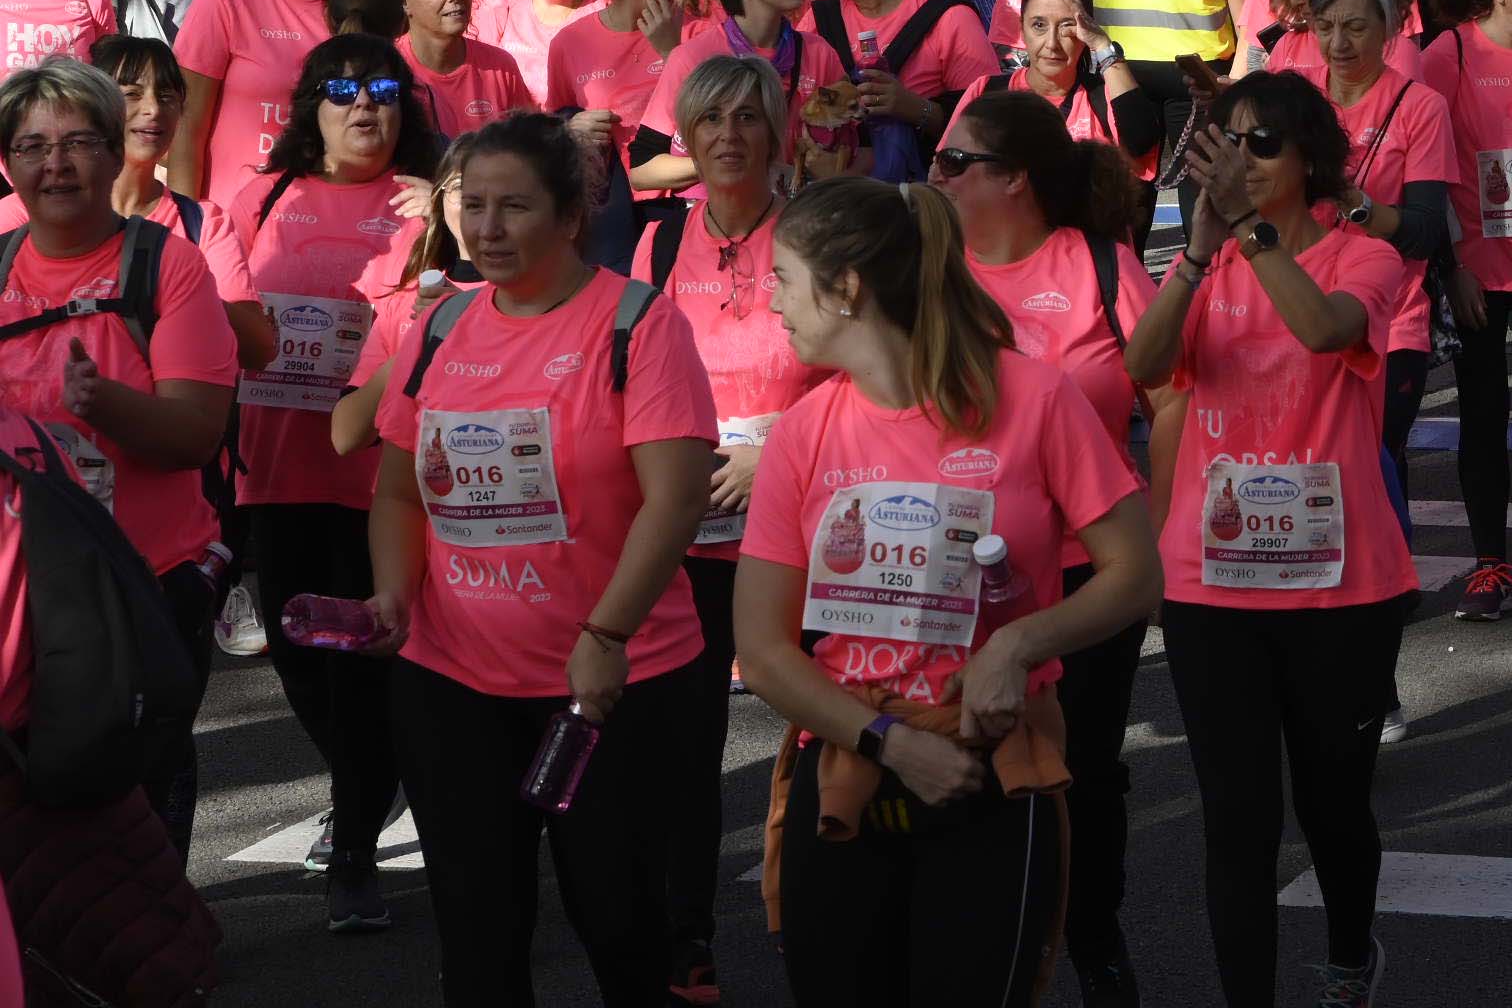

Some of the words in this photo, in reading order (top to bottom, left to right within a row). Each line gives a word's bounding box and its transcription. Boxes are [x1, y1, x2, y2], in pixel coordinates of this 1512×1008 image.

[7, 23, 80, 54] HOY
[260, 28, 302, 41] OYSHO
[576, 68, 616, 84] OYSHO
[1475, 77, 1511, 87] OYSHO
[260, 103, 291, 125] TU
[283, 316, 330, 328] ASTURIANA
[282, 338, 323, 357] 016
[283, 360, 315, 372] 29904
[444, 361, 501, 378] OYSHO
[509, 426, 539, 437] SUMA
[449, 435, 500, 448] ASTURIANA
[942, 459, 996, 473] ASTURIANA
[456, 466, 504, 485] 016
[823, 465, 888, 487] OYSHO
[468, 490, 496, 503] 1247
[1243, 487, 1296, 498] ASTURIANA
[470, 507, 481, 517] DE
[482, 507, 493, 516] LA
[495, 506, 523, 517] MUJER
[873, 508, 936, 525] ASTURIANA
[948, 508, 981, 521] SUMA
[507, 522, 553, 536] Santander
[1247, 515, 1294, 532] 016
[1252, 537, 1289, 549] 29907
[870, 542, 927, 567] 016
[1217, 551, 1253, 561] CARRERA
[1255, 552, 1267, 560] DE
[1268, 552, 1279, 560] LA
[1281, 552, 1309, 561] MUJER
[447, 554, 545, 592] SUMA
[879, 571, 913, 587] 1250
[1215, 567, 1256, 580] OYSHO
[1290, 568, 1333, 579] Santander
[828, 588, 875, 601] CARRERA
[877, 592, 891, 602] DE
[892, 594, 906, 603] LA
[906, 594, 938, 608] MUJER
[821, 608, 874, 625] OYSHO
[912, 617, 963, 632] Santander
